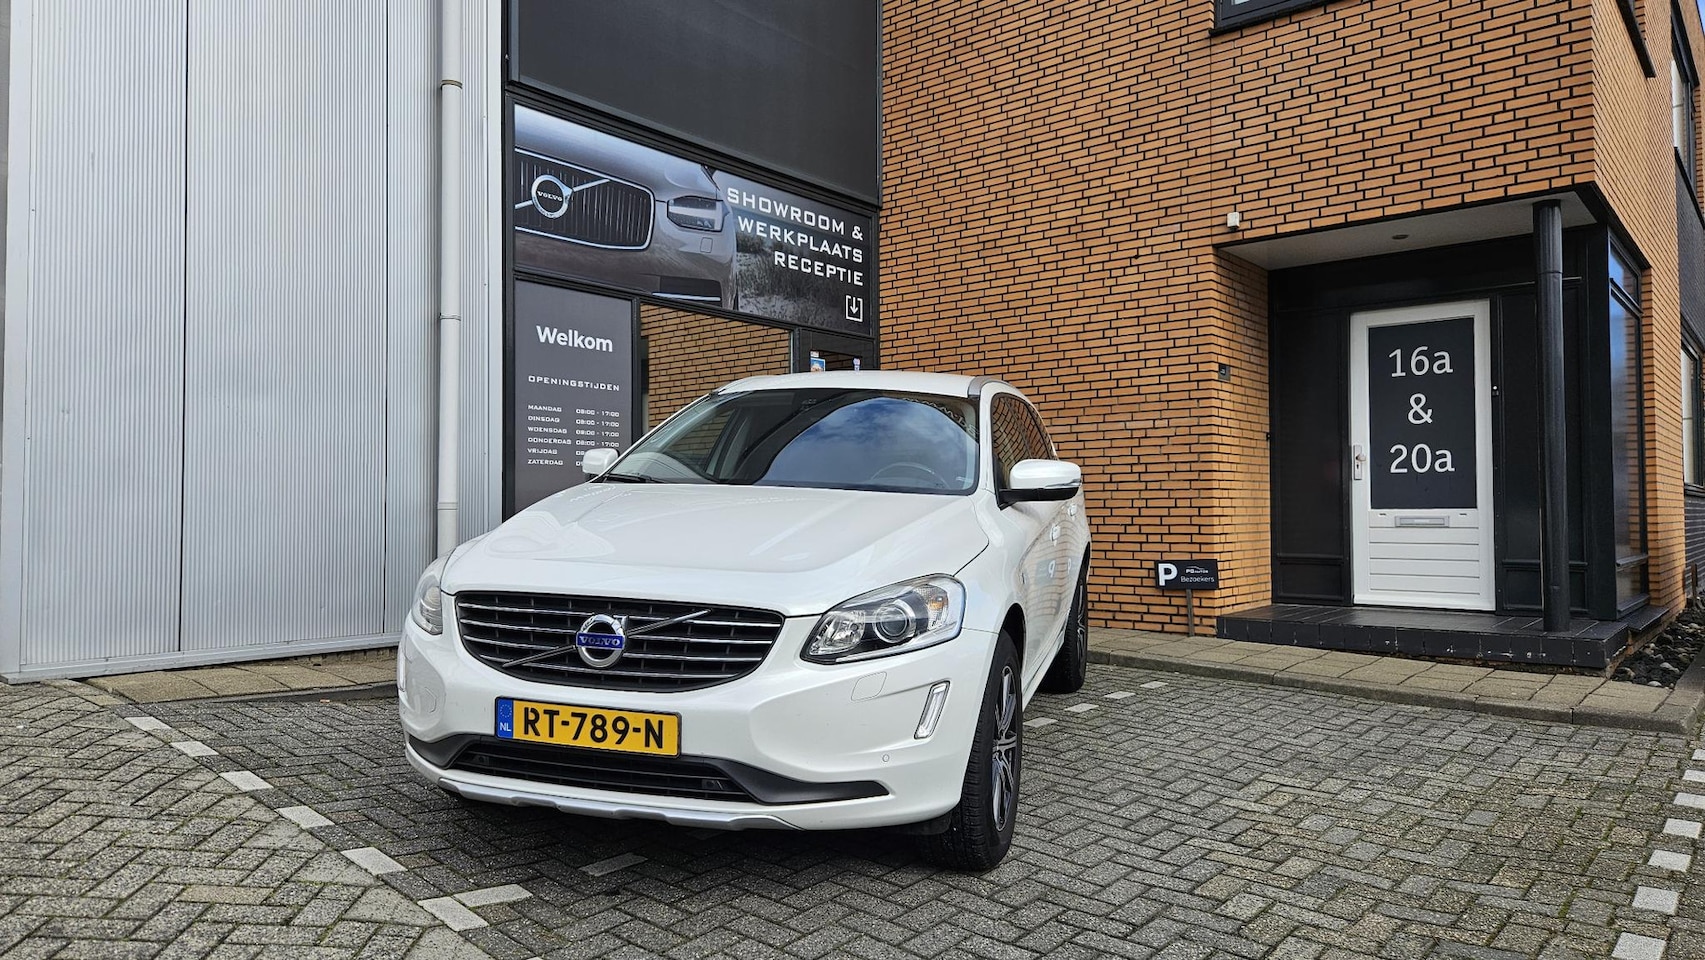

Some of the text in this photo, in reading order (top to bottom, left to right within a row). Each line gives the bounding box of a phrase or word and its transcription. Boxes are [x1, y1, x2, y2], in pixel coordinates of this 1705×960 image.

[537, 190, 562, 201] VOLVO
[727, 187, 863, 240] SHOWROOM &
[738, 215, 863, 263] WERKPLAATS
[774, 251, 863, 286] RECEPTIE
[536, 326, 613, 352] Welkom
[1388, 345, 1454, 378] 16a
[528, 376, 620, 391] OPENINGSTIJDEN
[1407, 393, 1433, 425] &
[1389, 443, 1455, 474] 20a
[1158, 563, 1178, 586] P
[579, 635, 621, 647] VOLVO
[500, 722, 511, 732] NL
[523, 706, 664, 749] RT-789-N
